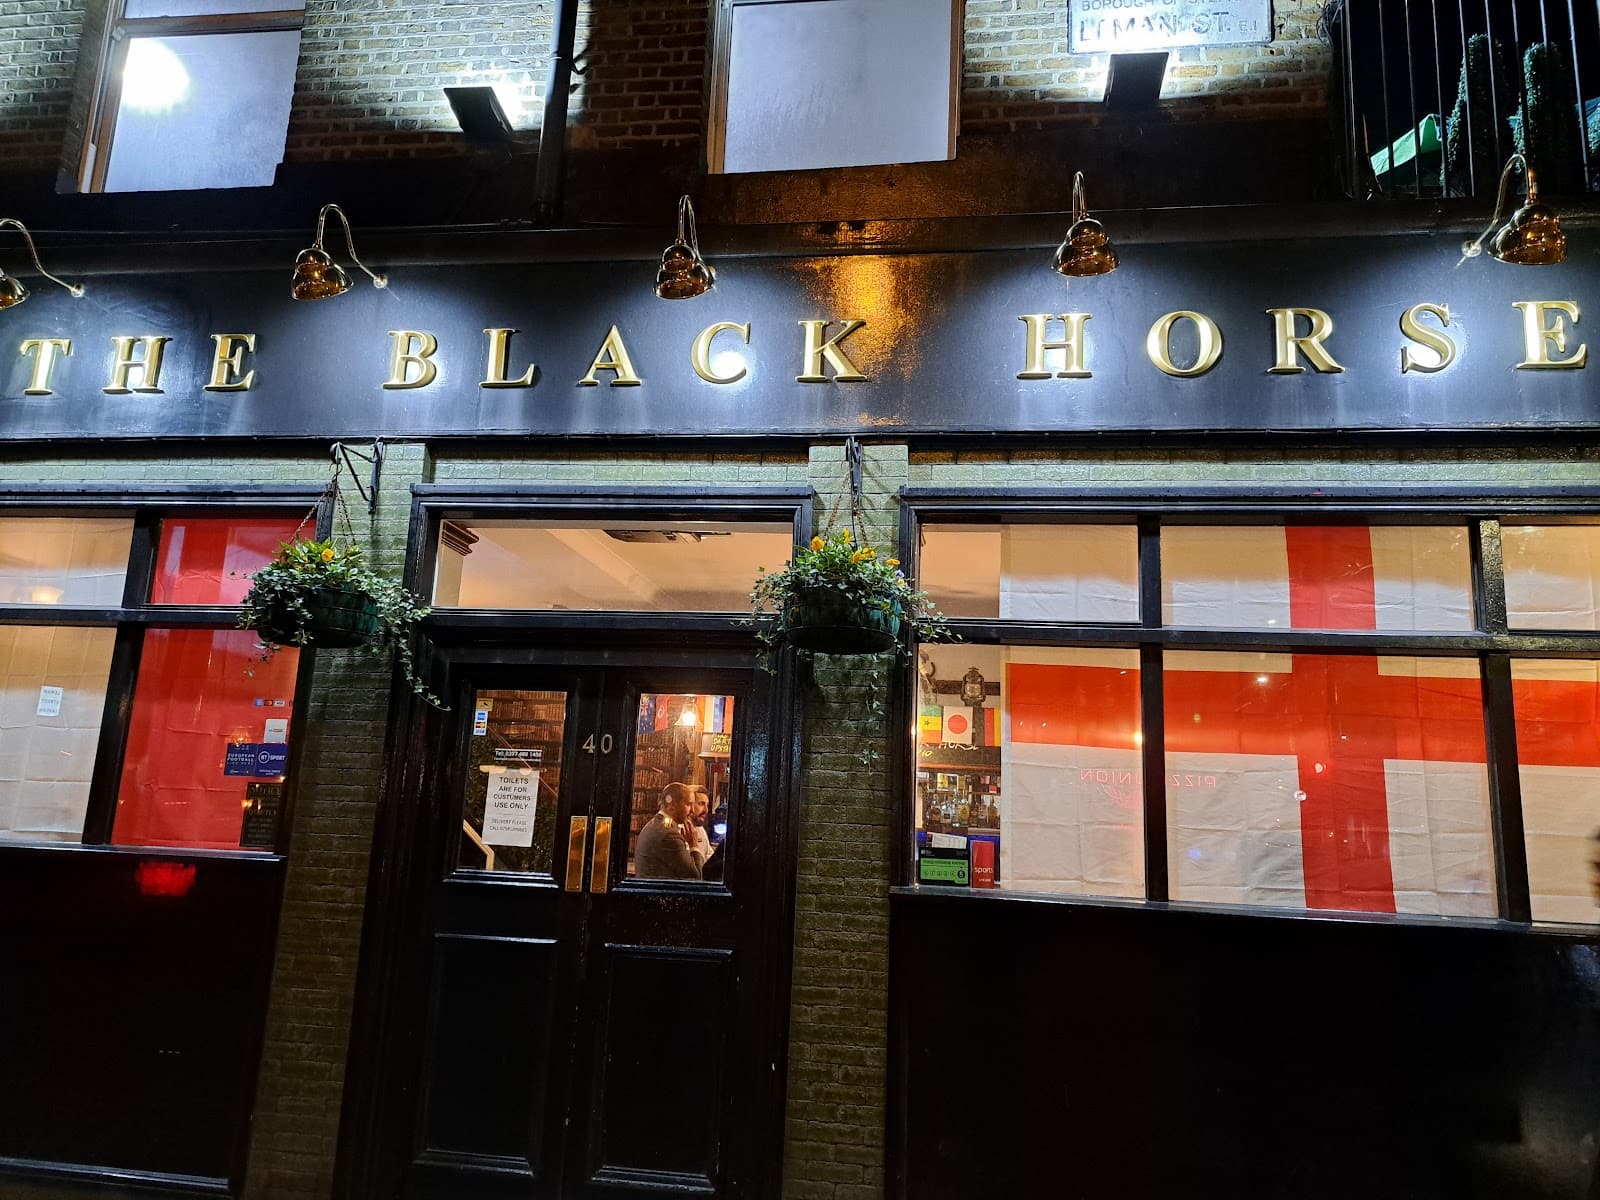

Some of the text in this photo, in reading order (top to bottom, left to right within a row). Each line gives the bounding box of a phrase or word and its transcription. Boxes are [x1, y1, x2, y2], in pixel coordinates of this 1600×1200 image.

[19, 300, 1588, 395] THE BLACK HORSE
[582, 733, 613, 754] 40
[499, 776, 529, 785] TOILETS
[498, 785, 512, 793] ARE
[494, 801, 529, 810] USE ONLY
